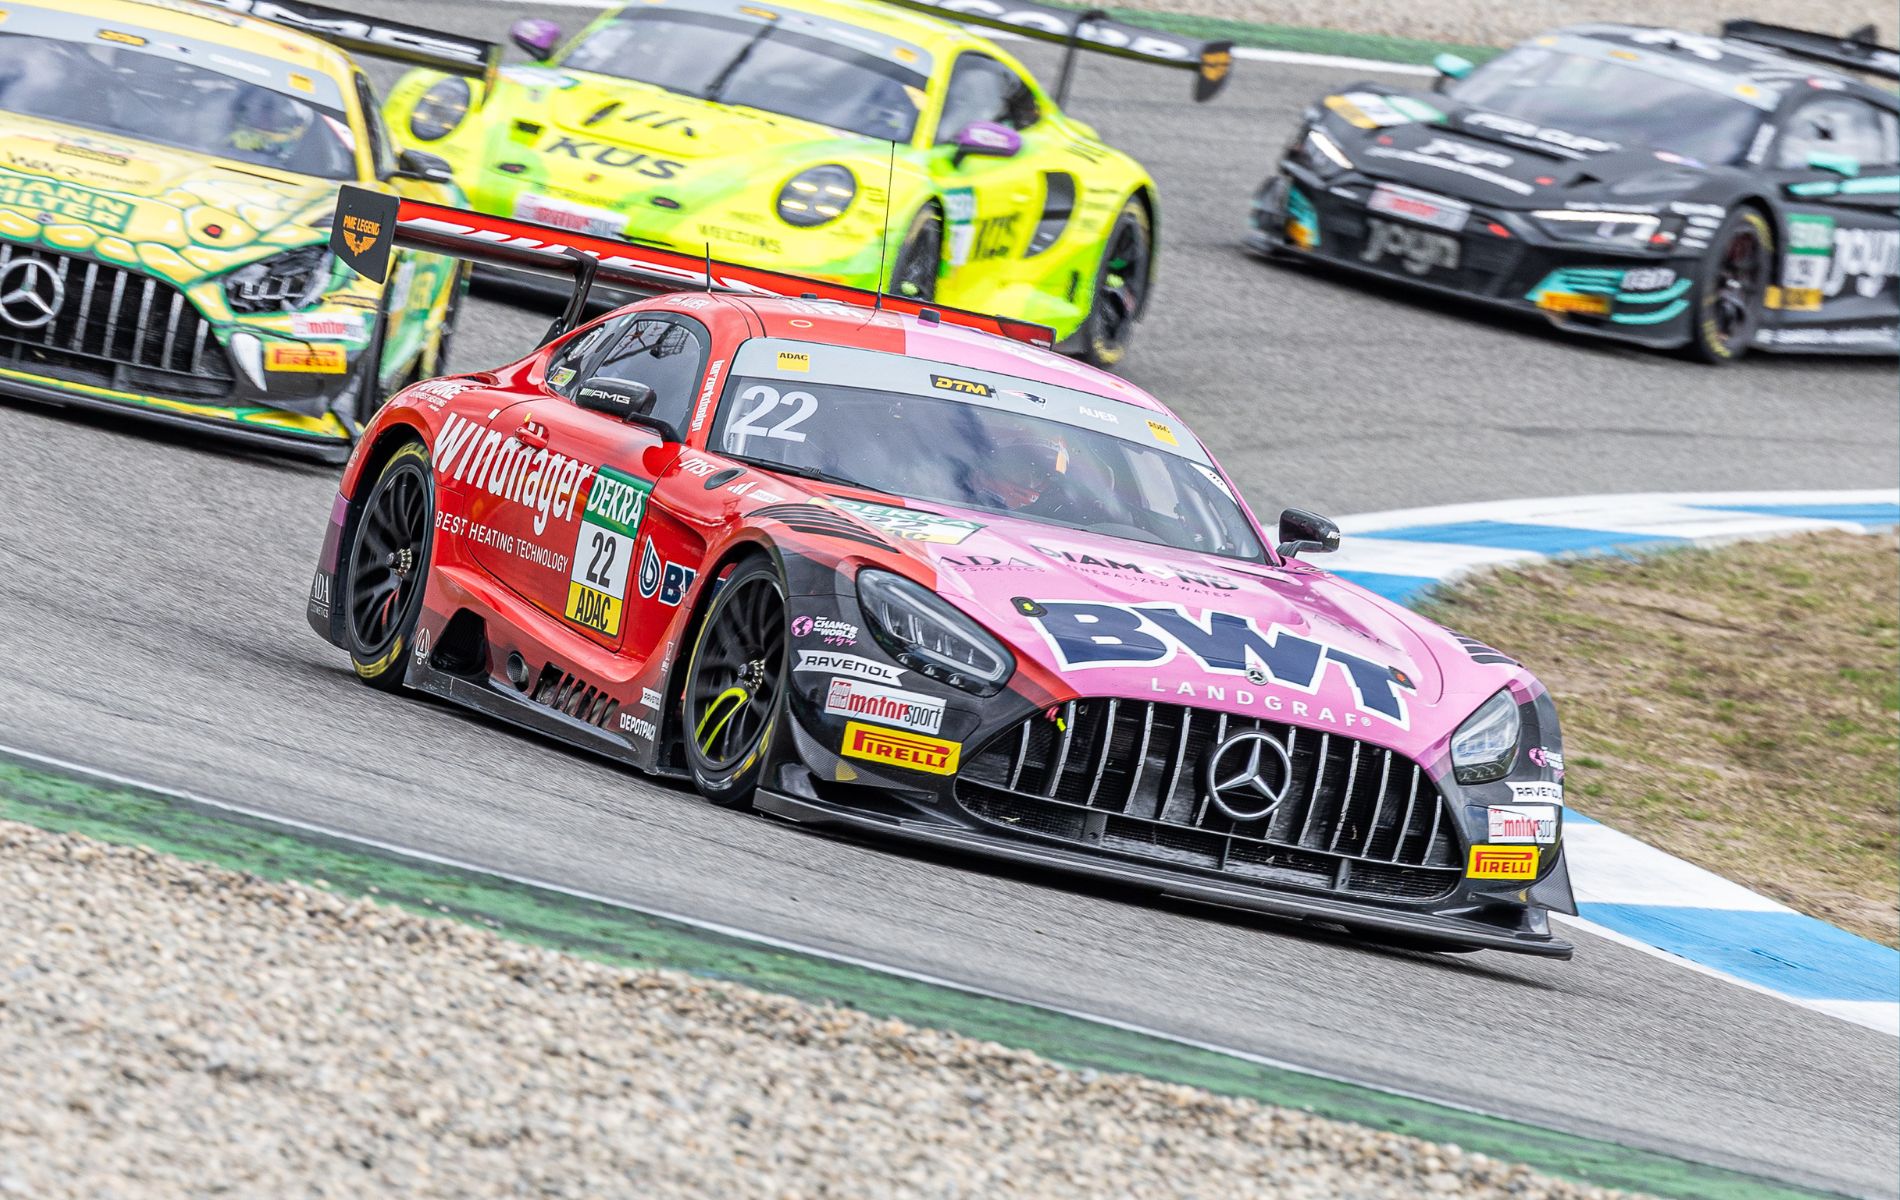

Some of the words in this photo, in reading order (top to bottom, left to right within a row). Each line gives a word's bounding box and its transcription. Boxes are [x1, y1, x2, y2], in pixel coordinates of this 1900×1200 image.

[0, 190, 122, 229] ILTER
[357, 217, 381, 235] LEGEND
[779, 352, 808, 362] ADAC
[592, 390, 631, 404] AMG
[935, 377, 987, 395] DTM
[730, 385, 819, 443] 22
[1079, 406, 1119, 425] AUER
[587, 476, 644, 529] DEKRA
[435, 511, 468, 536] BEST
[468, 521, 514, 554] HEATING
[516, 538, 569, 573] TECHNOLOGY
[586, 531, 617, 588] 22
[574, 588, 610, 631] ADAC
[814, 619, 858, 634] CHANGE
[805, 655, 893, 679] RAVENOL
[1029, 598, 1417, 731] BWT
[853, 729, 950, 768] PIRELLI
[1474, 852, 1533, 873] PIRELLI
